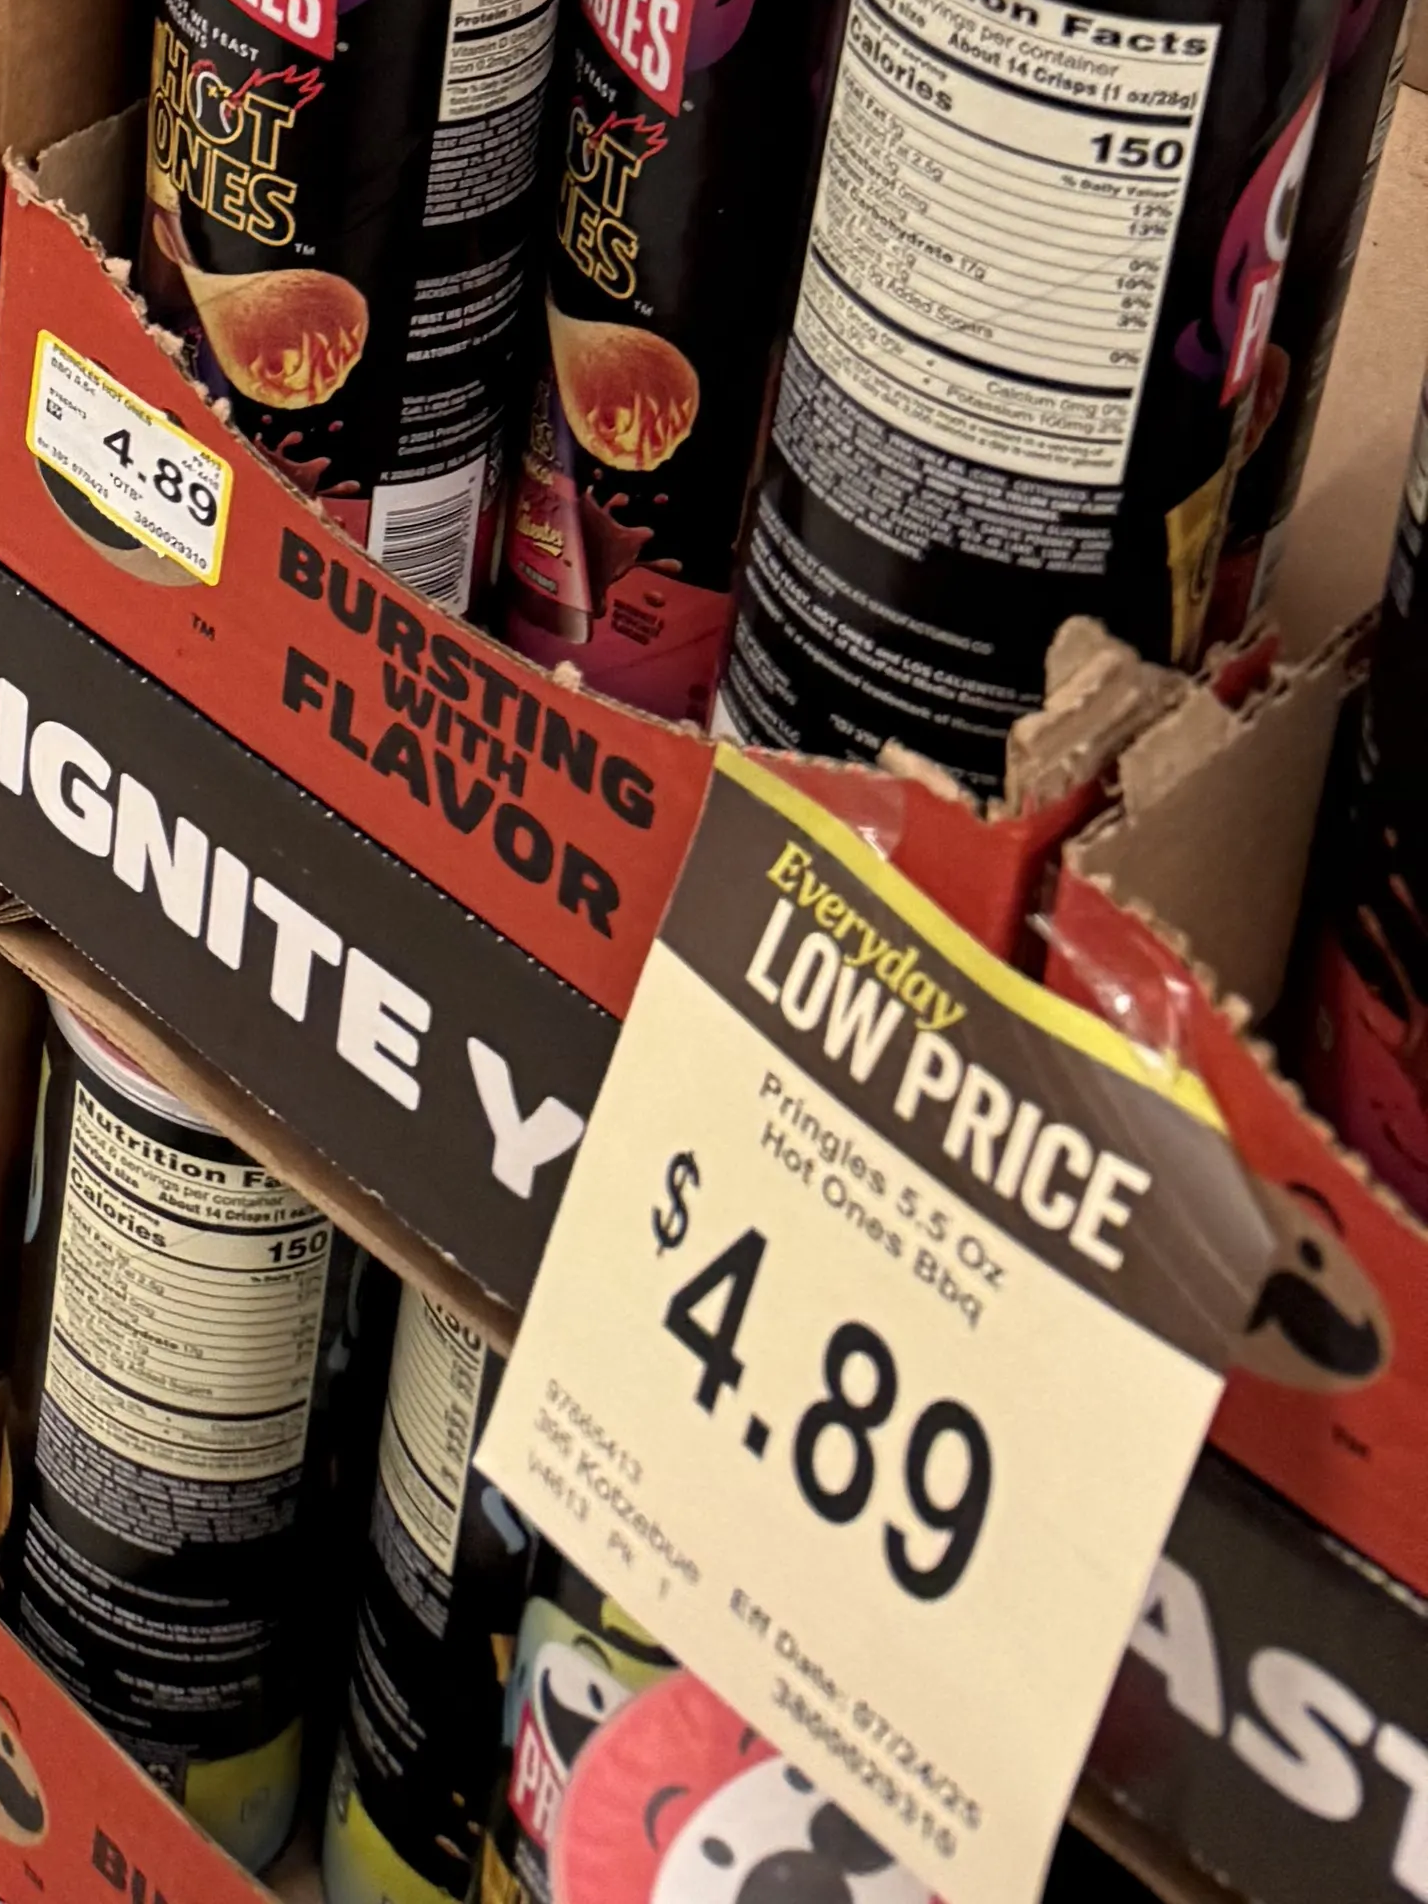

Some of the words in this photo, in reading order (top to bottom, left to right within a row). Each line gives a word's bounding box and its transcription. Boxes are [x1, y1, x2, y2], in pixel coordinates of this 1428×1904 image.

[212, 28, 261, 63] FEAST
[849, 13, 953, 113] Calories
[947, 32, 1002, 67] About
[1006, 56, 1029, 78] 14
[1032, 67, 1099, 97] Crisps
[979, 24, 1015, 51] per
[1017, 39, 1120, 79] container
[1061, 12, 1209, 58] Facts
[156, 25, 298, 171] HOT
[150, 90, 299, 249] ONES
[1090, 132, 1186, 171] 150
[103, 427, 218, 528] 4.89
[190, 612, 218, 641] TM
[280, 525, 656, 831] BURSTING
[381, 660, 526, 795] WITH
[280, 645, 624, 941] FLAVOR
[765, 839, 968, 1032] Everyday
[465, 1036, 587, 1200] Y
[744, 896, 906, 1085] LOW
[892, 1028, 1154, 1273] PRICE
[77, 1087, 227, 1185] Nutrition
[756, 1069, 887, 1196] Pringles
[894, 1186, 946, 1245] 5.5
[954, 1232, 1007, 1292] Oz
[70, 1166, 167, 1249] Calories
[157, 1190, 203, 1215] About
[182, 1183, 212, 1204] per
[211, 1191, 286, 1208] container
[759, 1121, 816, 1188] Hot
[819, 1172, 905, 1261] Ones
[911, 1248, 984, 1333] Bbq
[267, 1229, 328, 1264] 150
[576, 1448, 702, 1587] Kotzebue
